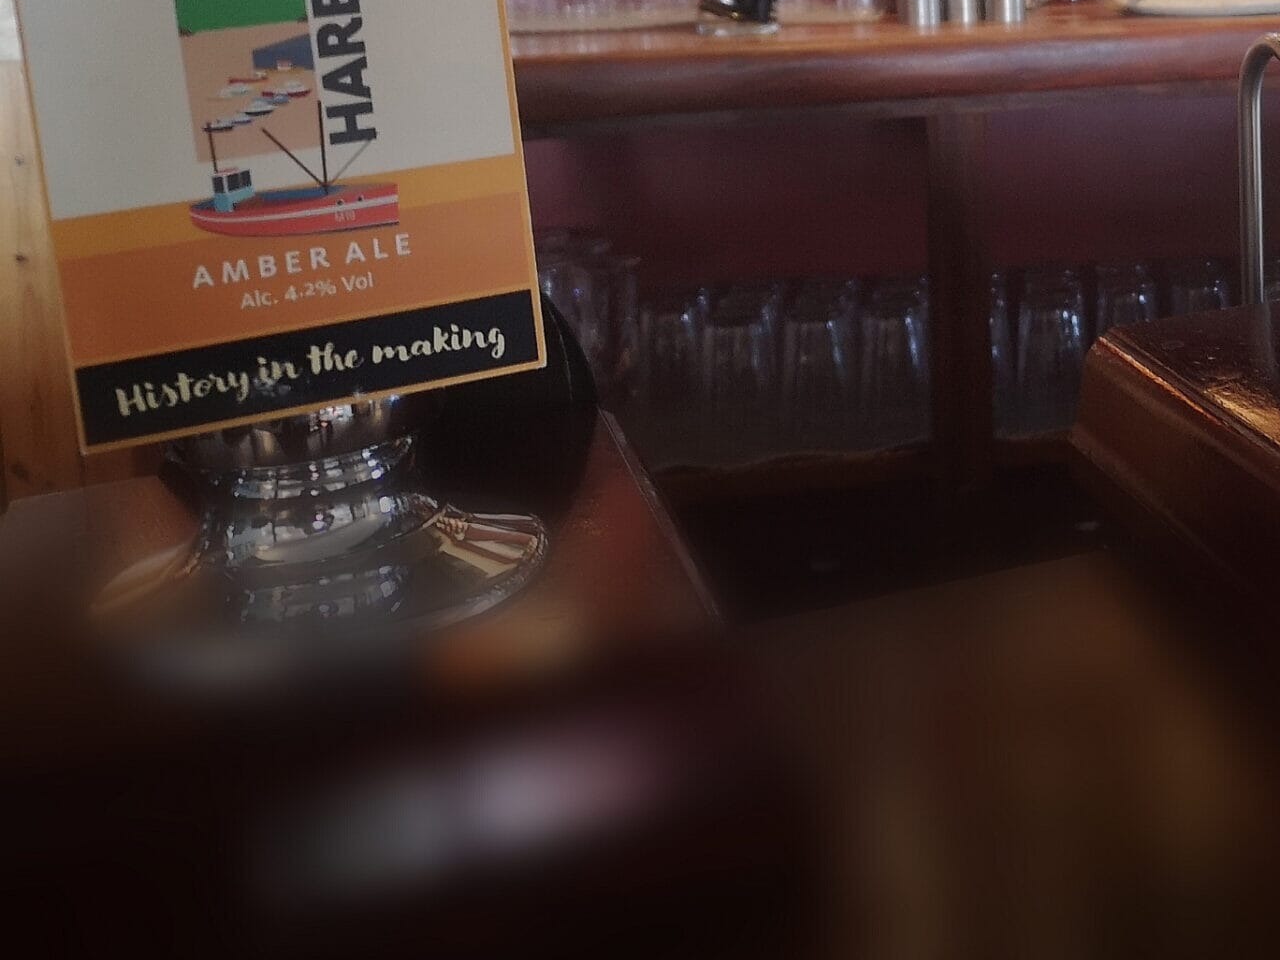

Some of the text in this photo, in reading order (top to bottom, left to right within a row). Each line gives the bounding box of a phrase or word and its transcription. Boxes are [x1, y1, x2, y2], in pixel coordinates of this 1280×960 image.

[192, 232, 412, 289] AMBER ALE
[240, 271, 374, 310] Alc. 4.2% Vol
[115, 324, 506, 417] History in the making
